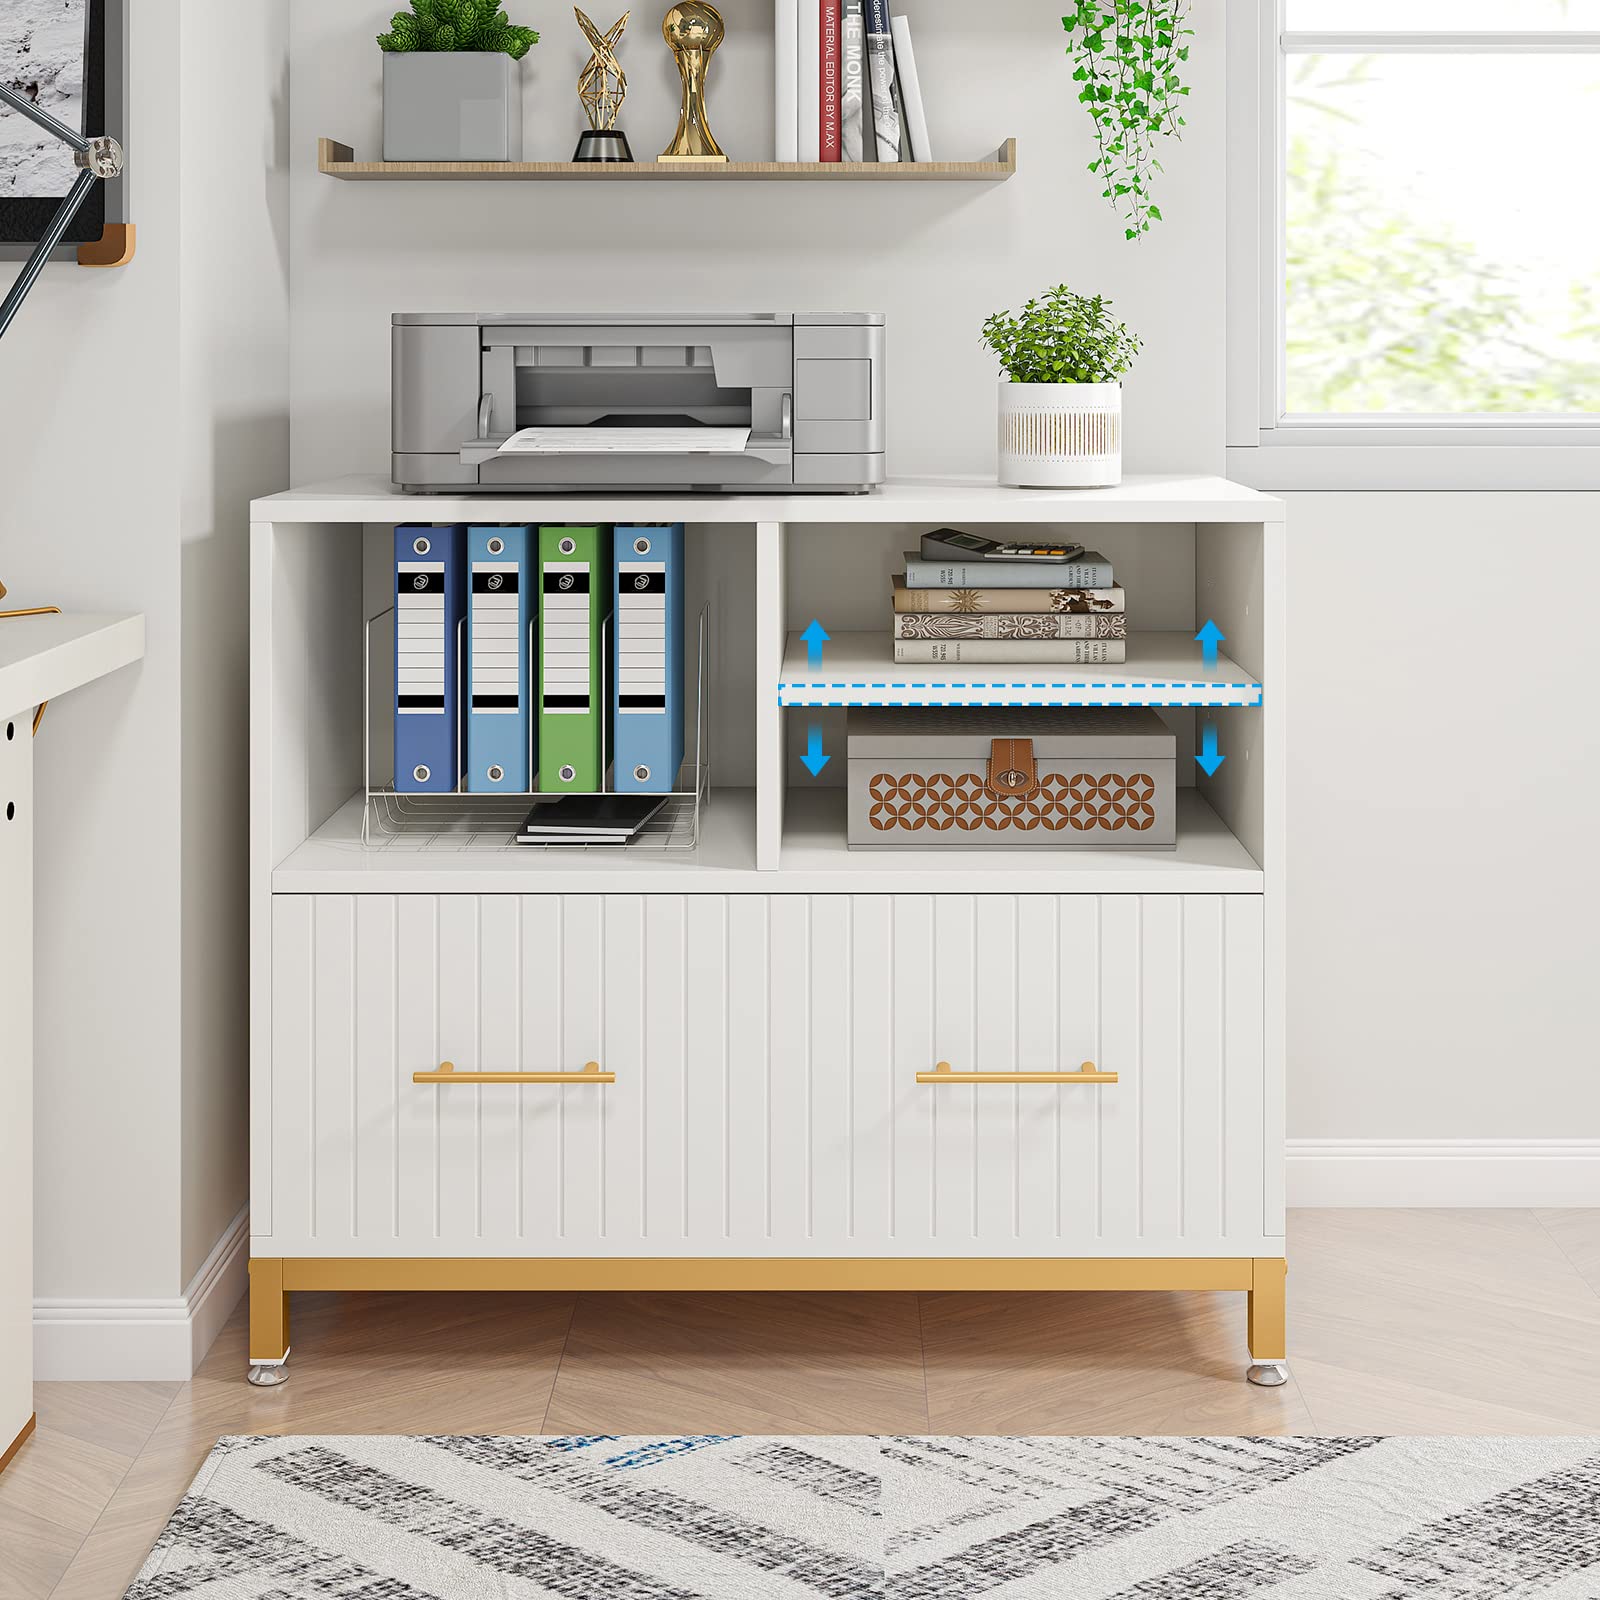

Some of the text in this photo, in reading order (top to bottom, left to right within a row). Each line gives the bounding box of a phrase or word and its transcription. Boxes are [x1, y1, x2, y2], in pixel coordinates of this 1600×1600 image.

[825, 6, 835, 59] MATERIAL
[847, 1, 862, 102] THE MONK
[877, 51, 887, 66] the
[825, 61, 835, 102] EDITOR
[825, 104, 835, 119] BY
